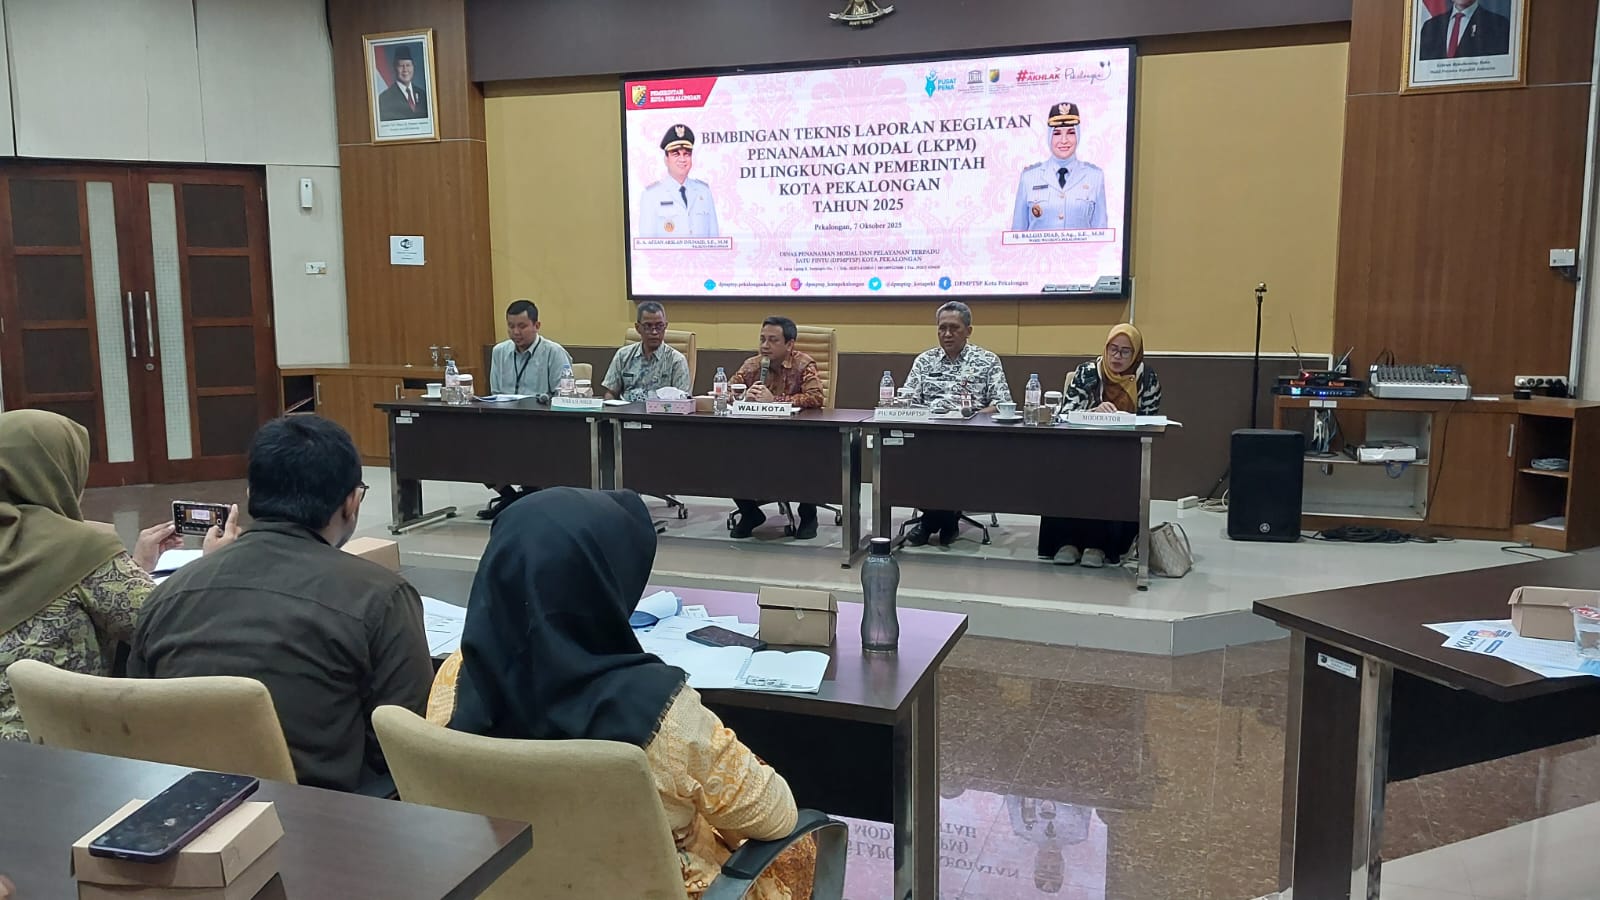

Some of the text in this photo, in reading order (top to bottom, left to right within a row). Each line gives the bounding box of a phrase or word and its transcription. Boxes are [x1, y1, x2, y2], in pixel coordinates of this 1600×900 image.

[701, 114, 1033, 145] BIMBINGAN TEKNIS LAPORAN KEGIATAN
[747, 137, 977, 161] PENANAMAN MODAL (LKPM)
[740, 157, 985, 179] DI LINGKUNGAN PEMERINTAH
[779, 178, 941, 196] KOTA PEKALONGAN
[812, 198, 904, 214] TAHUN 2025
[814, 223, 852, 232] Pekalongan,
[859, 222, 886, 230] Oktober
[887, 221, 903, 229] 2025
[1082, 414, 1121, 422] MODERATOR
